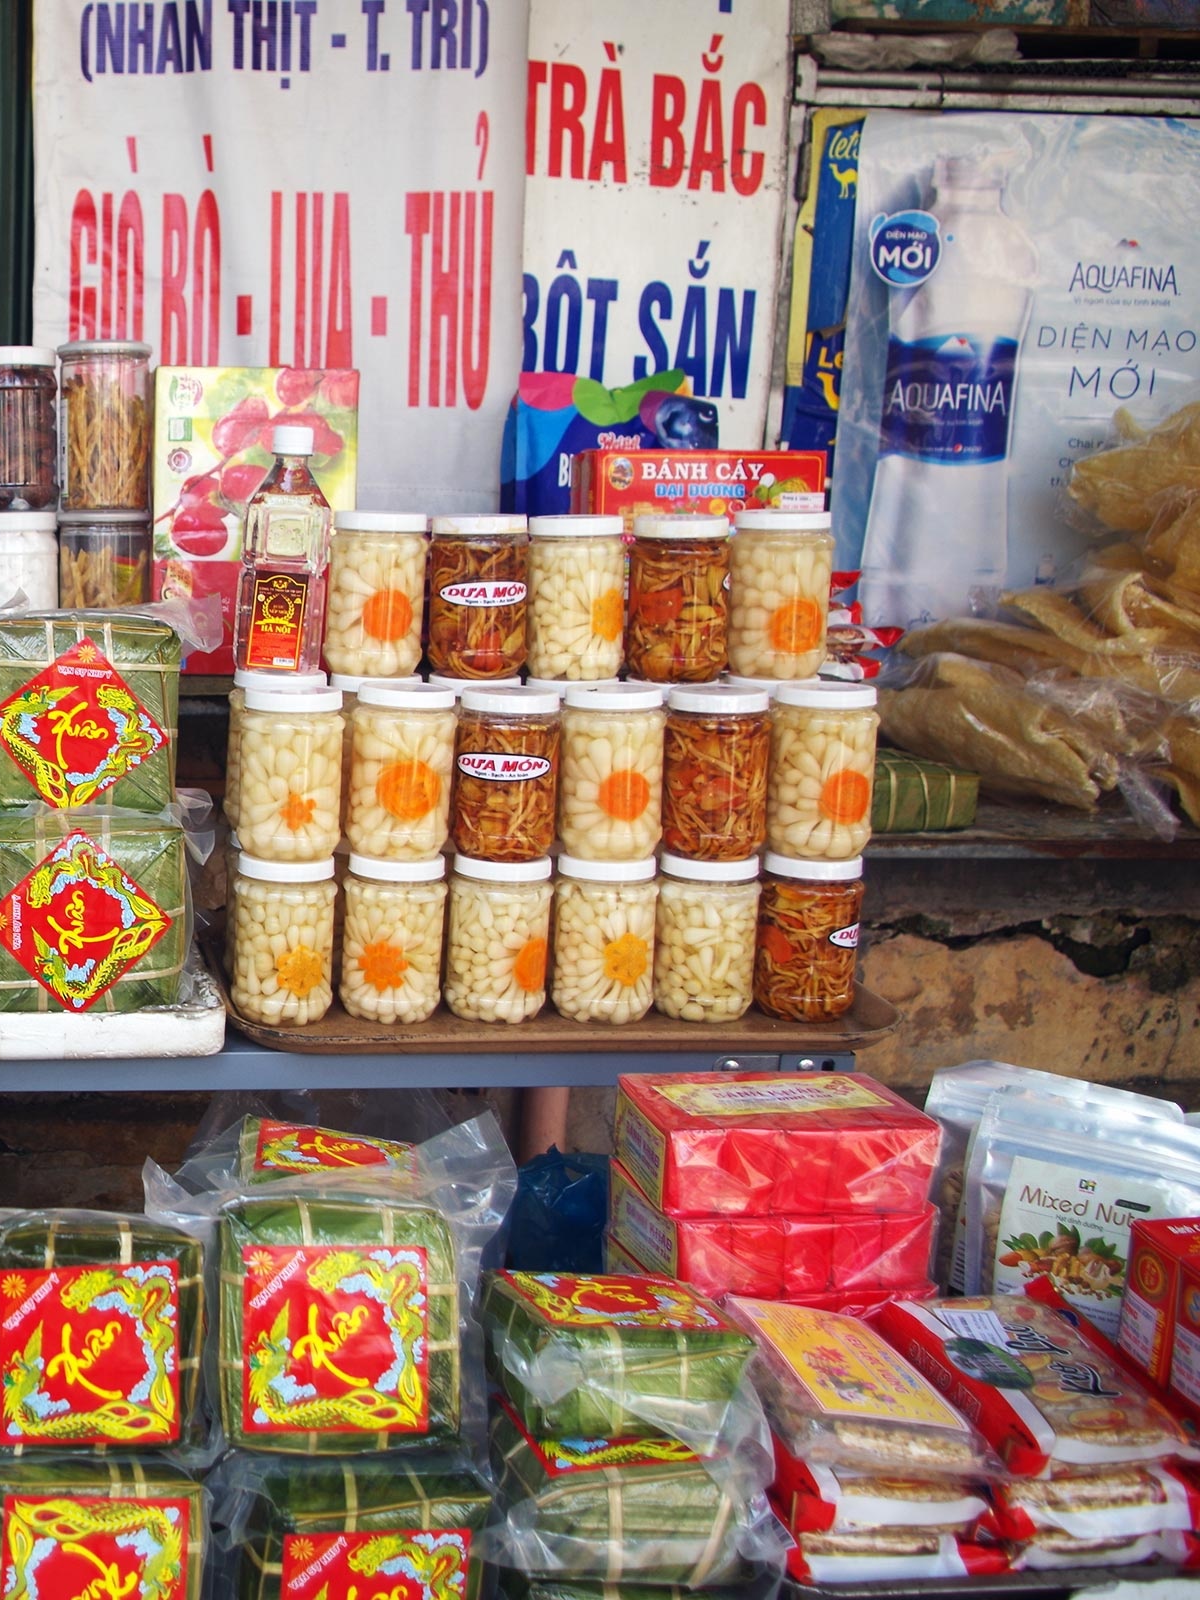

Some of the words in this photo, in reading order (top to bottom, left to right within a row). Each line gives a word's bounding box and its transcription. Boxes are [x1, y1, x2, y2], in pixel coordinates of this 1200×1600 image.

[228, 0, 318, 89] THỊT
[652, 34, 767, 196] BẮC
[405, 111, 494, 410] THỦ
[878, 241, 932, 270] MỚI
[1069, 261, 1181, 296] AQUAFINA
[633, 240, 756, 400] SẮN
[1037, 322, 1112, 353] DIỆN
[1126, 329, 1196, 356] MẠO
[886, 379, 1007, 417] AQUAFINA
[1069, 358, 1156, 400] MỚI
[641, 458, 708, 481] BÁNH
[716, 458, 764, 481] CÁY
[448, 586, 488, 598] DƯA
[492, 582, 525, 598] MÓN
[261, 623, 273, 633] HÀ
[275, 624, 291, 635] NỘI
[48, 701, 109, 770] Xuân
[461, 757, 496, 772] DƯA
[501, 758, 544, 772] MÓN
[1019, 1184, 1089, 1217] Mixed
[1095, 1202, 1149, 1229] Nut
[46, 1320, 123, 1400] Xuân
[292, 1302, 369, 1387] Xuân
